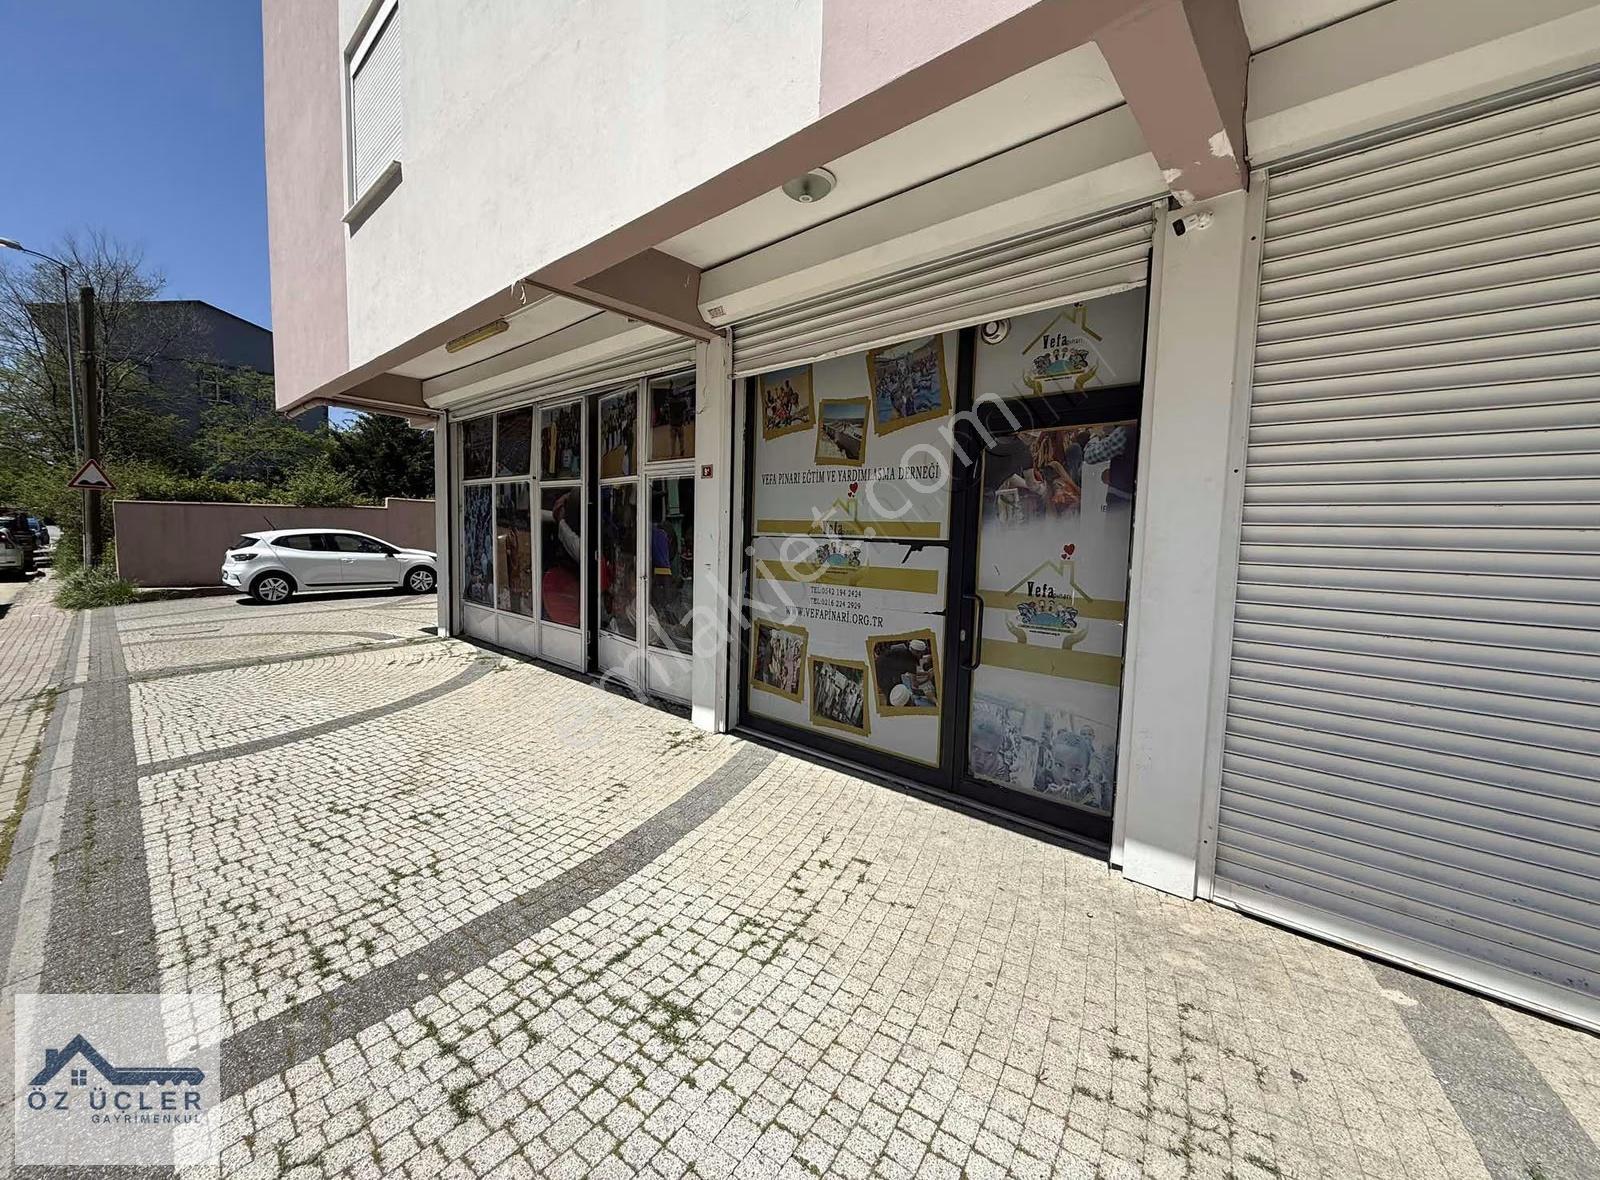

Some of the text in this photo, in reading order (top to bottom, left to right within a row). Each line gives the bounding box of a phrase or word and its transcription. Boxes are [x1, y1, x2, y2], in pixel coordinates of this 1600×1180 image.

[1043, 333, 1068, 349] Vefa
[762, 473, 777, 486] VEFA
[827, 470, 836, 483] VE
[838, 467, 896, 482] YARDIMLAŞMA
[898, 462, 940, 480] DERNEĞİ
[1027, 581, 1054, 598] Vefa
